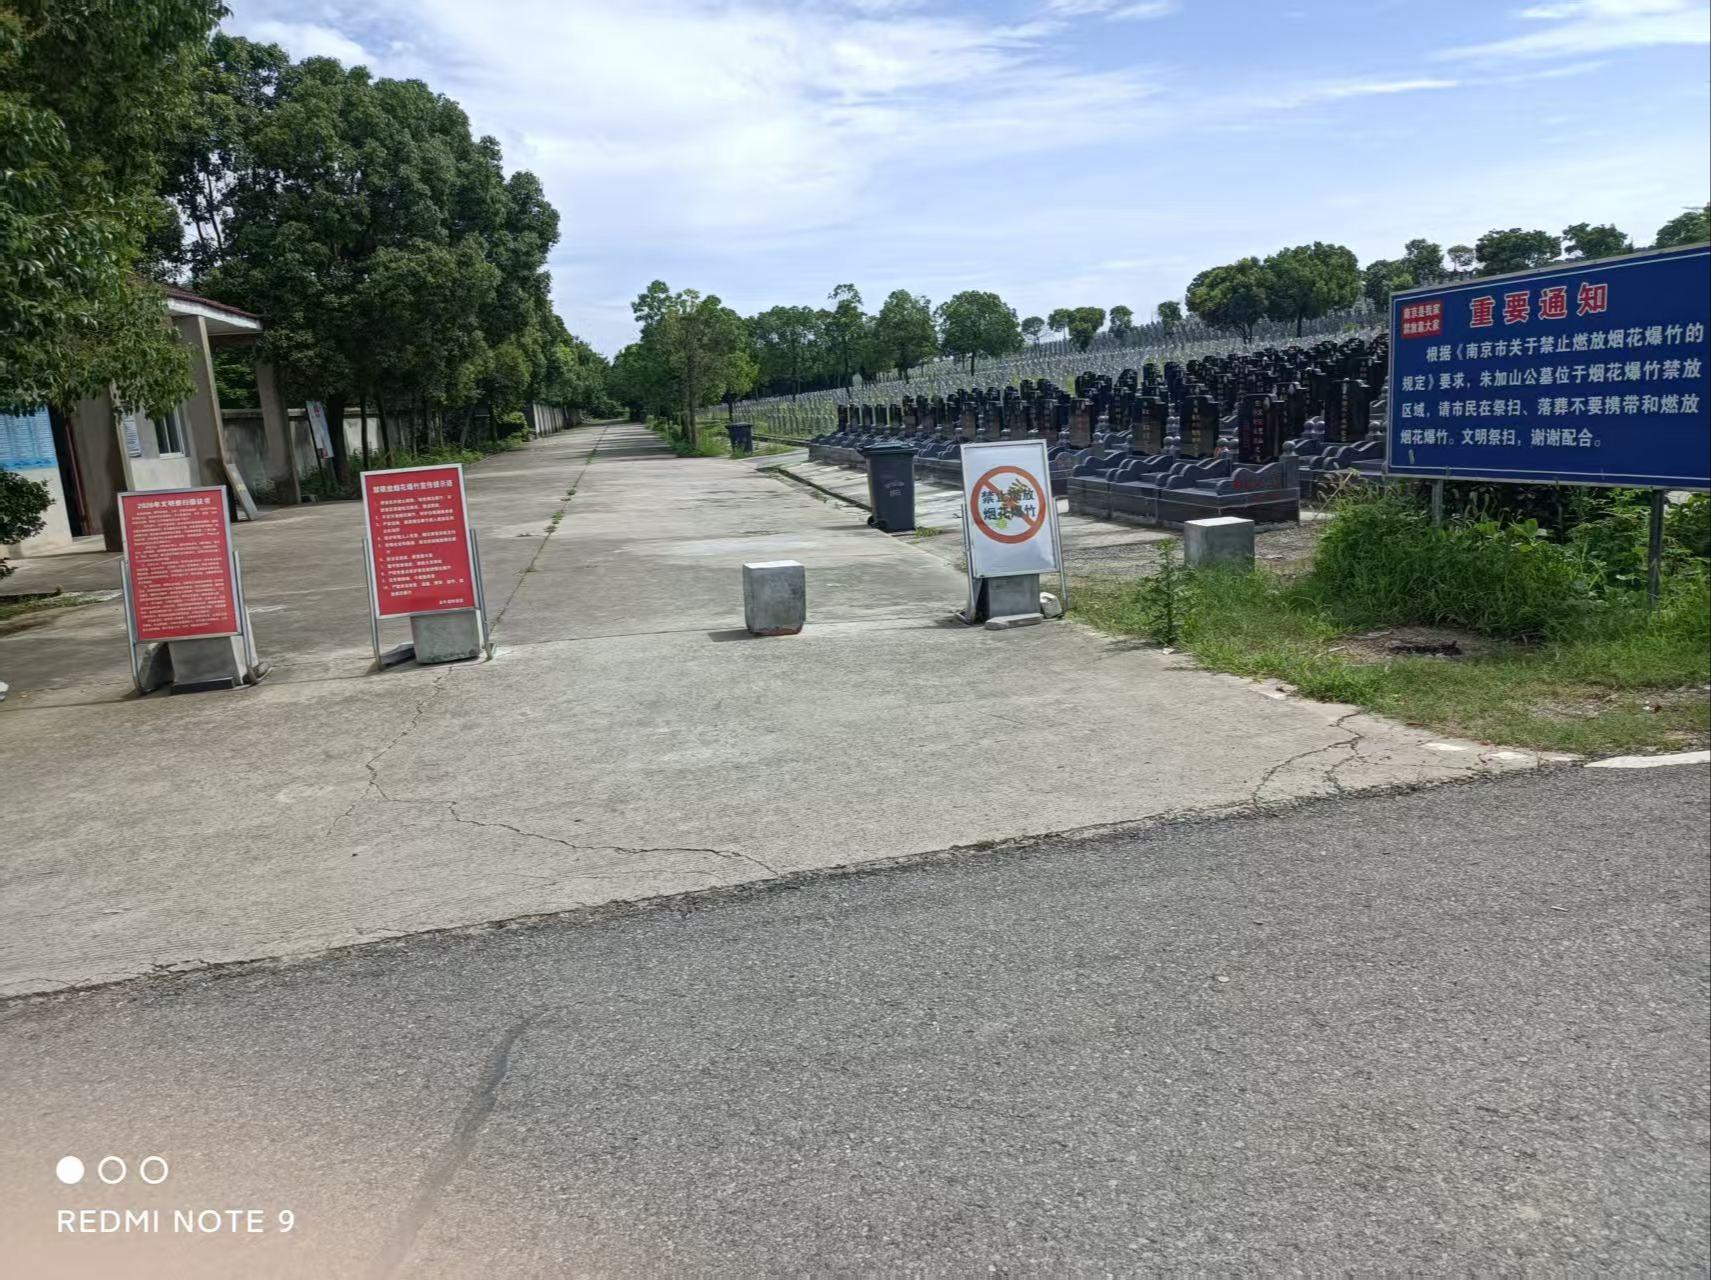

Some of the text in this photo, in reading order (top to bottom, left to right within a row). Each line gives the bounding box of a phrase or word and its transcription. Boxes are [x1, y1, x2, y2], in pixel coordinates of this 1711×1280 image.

[1470, 282, 1608, 328] 重要通知
[1426, 322, 1704, 363] 根据《南京市关于禁止燃放烟花爆竹的
